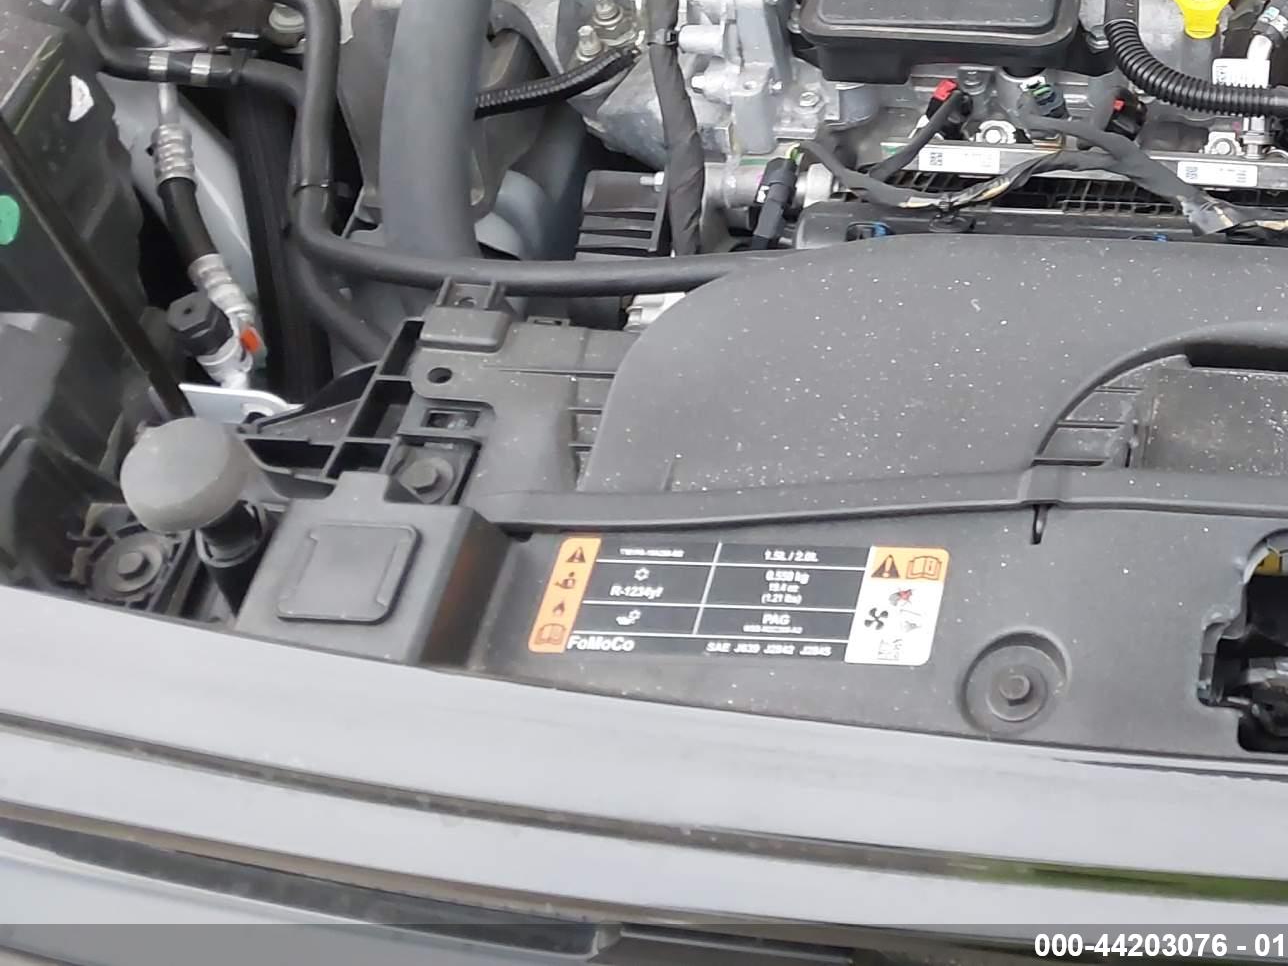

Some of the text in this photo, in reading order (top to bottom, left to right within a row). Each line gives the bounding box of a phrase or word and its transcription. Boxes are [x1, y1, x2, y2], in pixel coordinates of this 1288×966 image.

[610, 585, 664, 599] R-1234yf
[762, 613, 791, 625] PAG
[567, 636, 635, 652] FoMoCo
[706, 642, 731, 653] SAE
